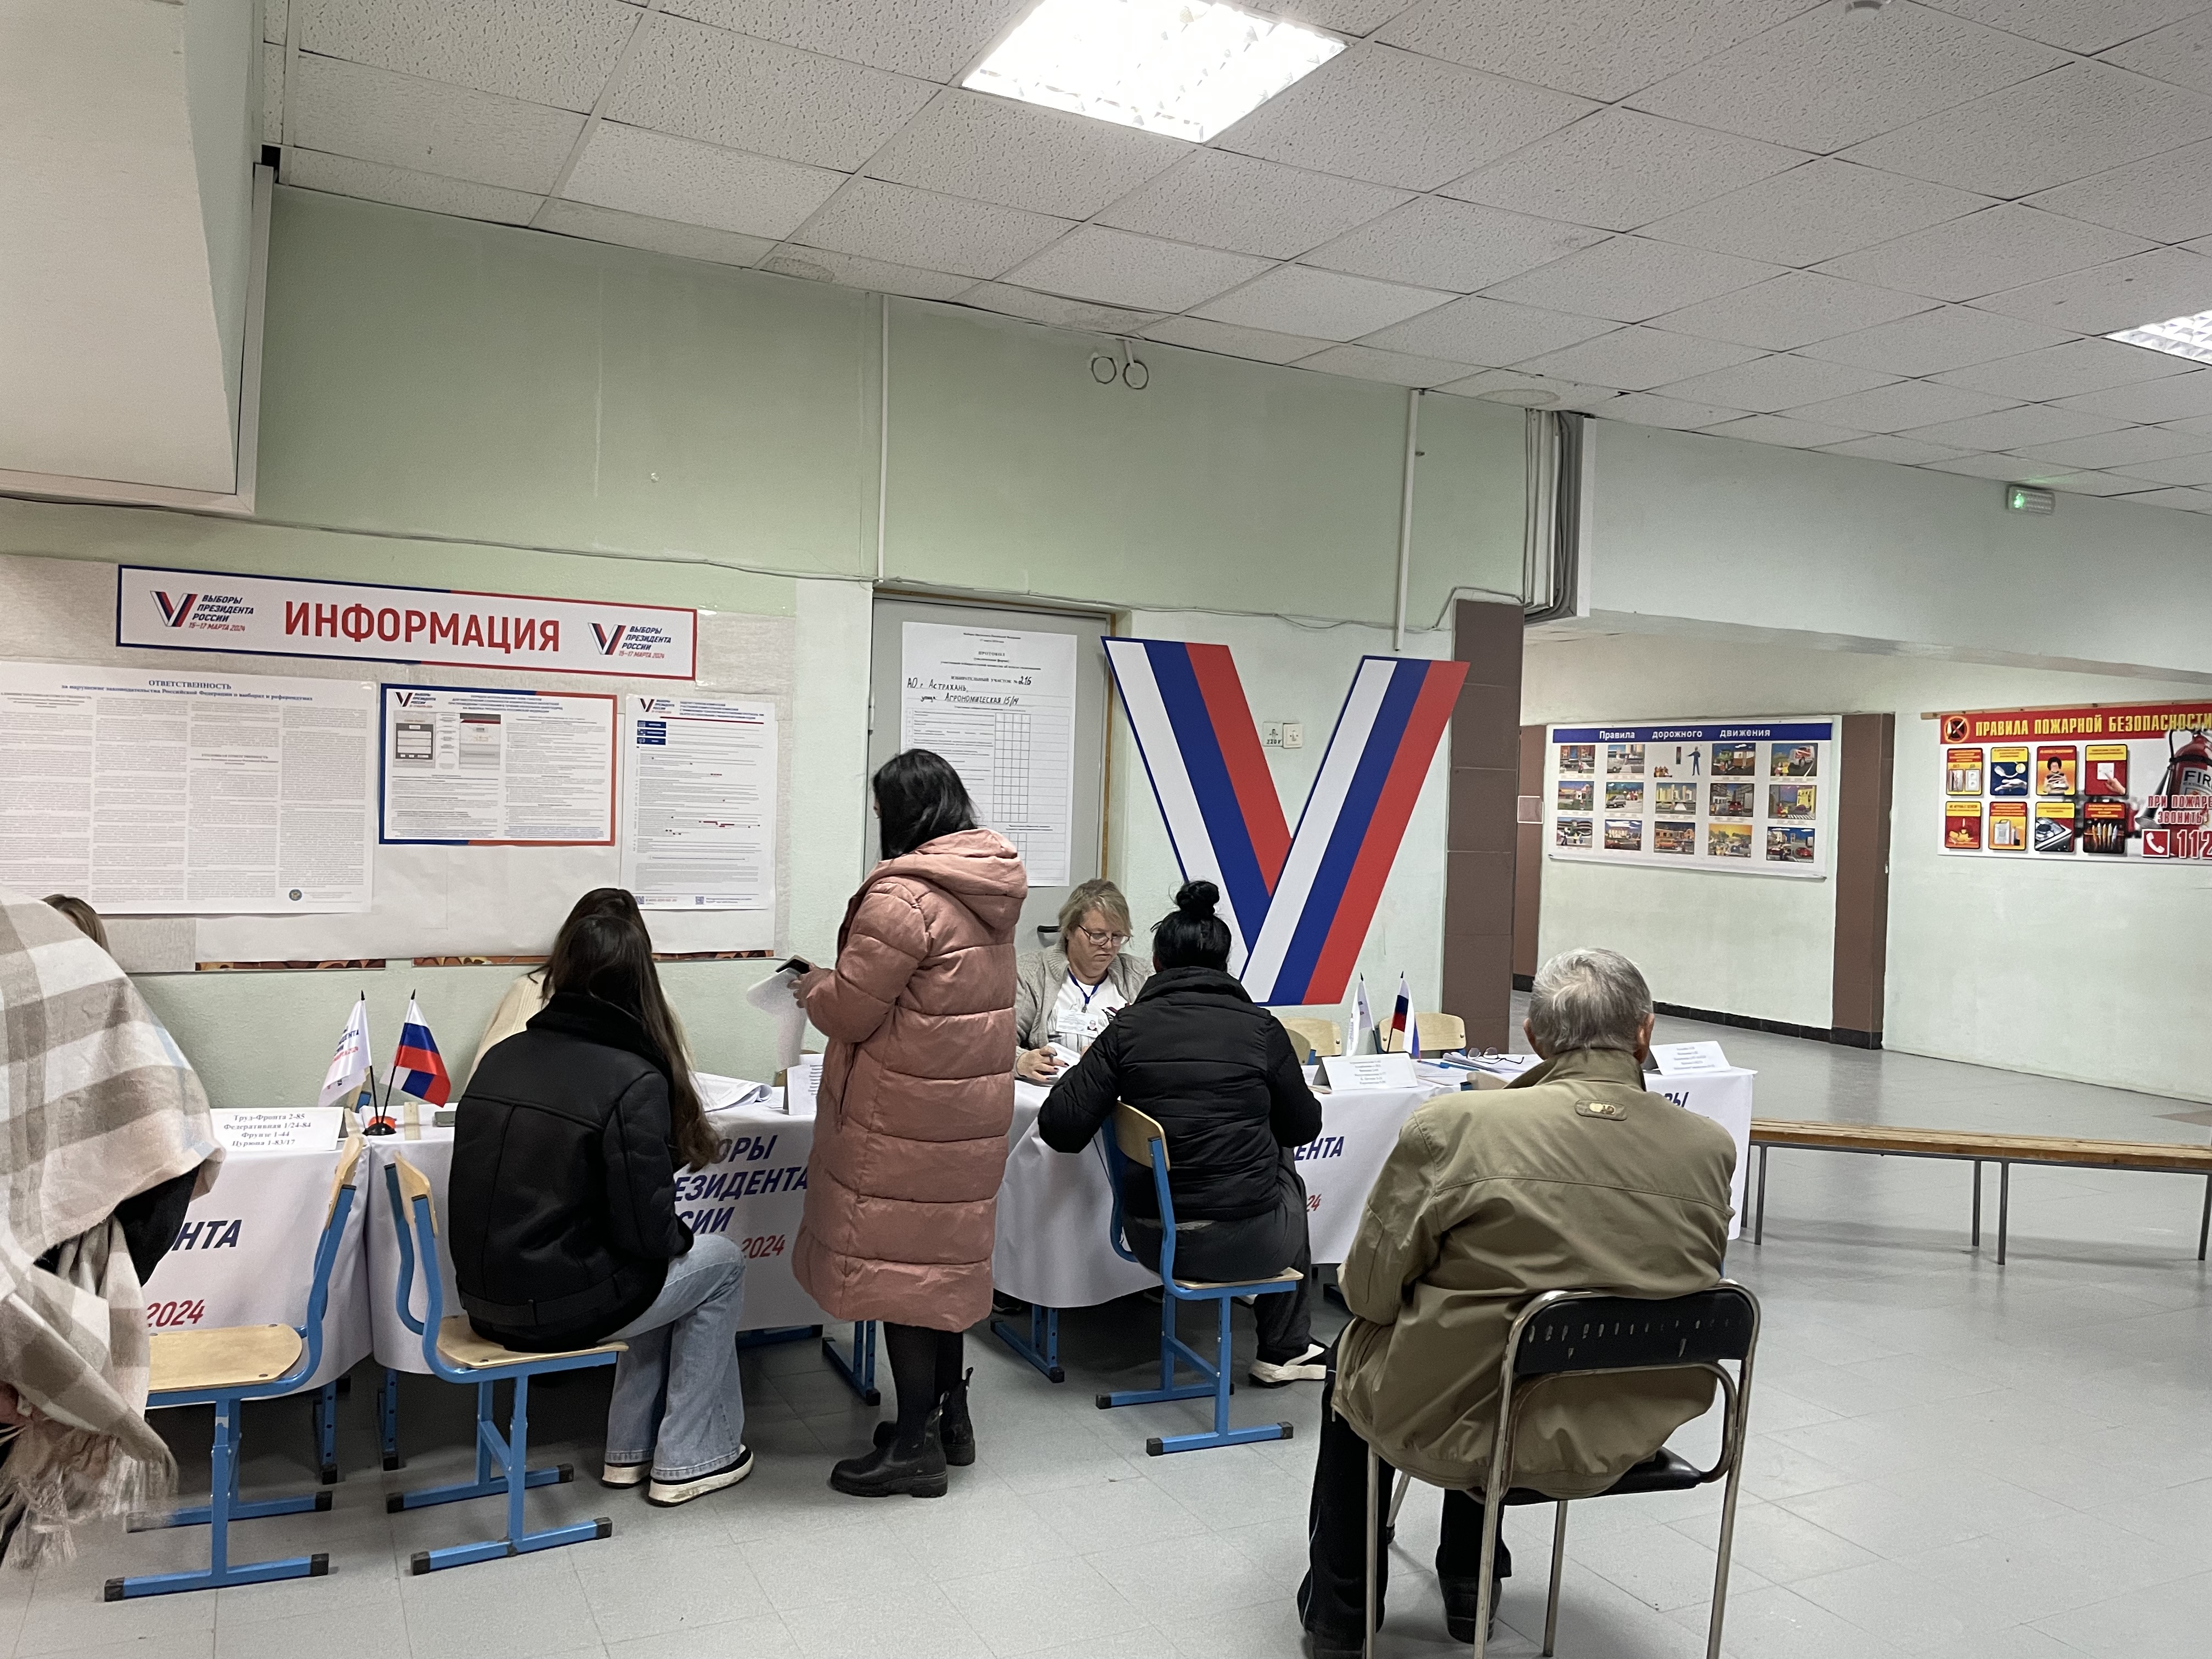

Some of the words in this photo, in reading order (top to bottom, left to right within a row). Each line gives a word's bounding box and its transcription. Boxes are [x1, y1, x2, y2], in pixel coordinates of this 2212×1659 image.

[202, 595, 242, 604] ВЫБОРЫ
[197, 604, 254, 614] ПРЕЗИДЕНТА
[193, 613, 229, 622] РОССИИ
[285, 601, 560, 654] ИНФОРМАЦИЯ
[625, 634, 672, 643] ПРЕЗИДЕНТА
[149, 680, 232, 690] ОТВЕТСТВЕННОСТЬ
[1976, 720, 2029, 737] ПРАВИЛА
[2034, 715, 2103, 735] ПОЖАРНОЙ
[2108, 713, 2212, 732] БЕЗОПАСНОСТИ
[1599, 731, 1635, 741] Правила
[1652, 730, 1702, 740] дорожного
[1719, 729, 1770, 738] движения
[2184, 770, 2211, 788] FIR
[2148, 795, 2167, 809] ПРИ
[2171, 795, 2212, 809] ПОЖАРЕ
[2157, 811, 2203, 825] ЗВОНИТЬ
[2177, 829, 2212, 859] 112
[712, 1135, 777, 1164] ОРЫ
[674, 1166, 808, 1201] ЕЗИДЕНТА
[1307, 1194, 1322, 1212] 24
[147, 1299, 205, 1327] 2024
